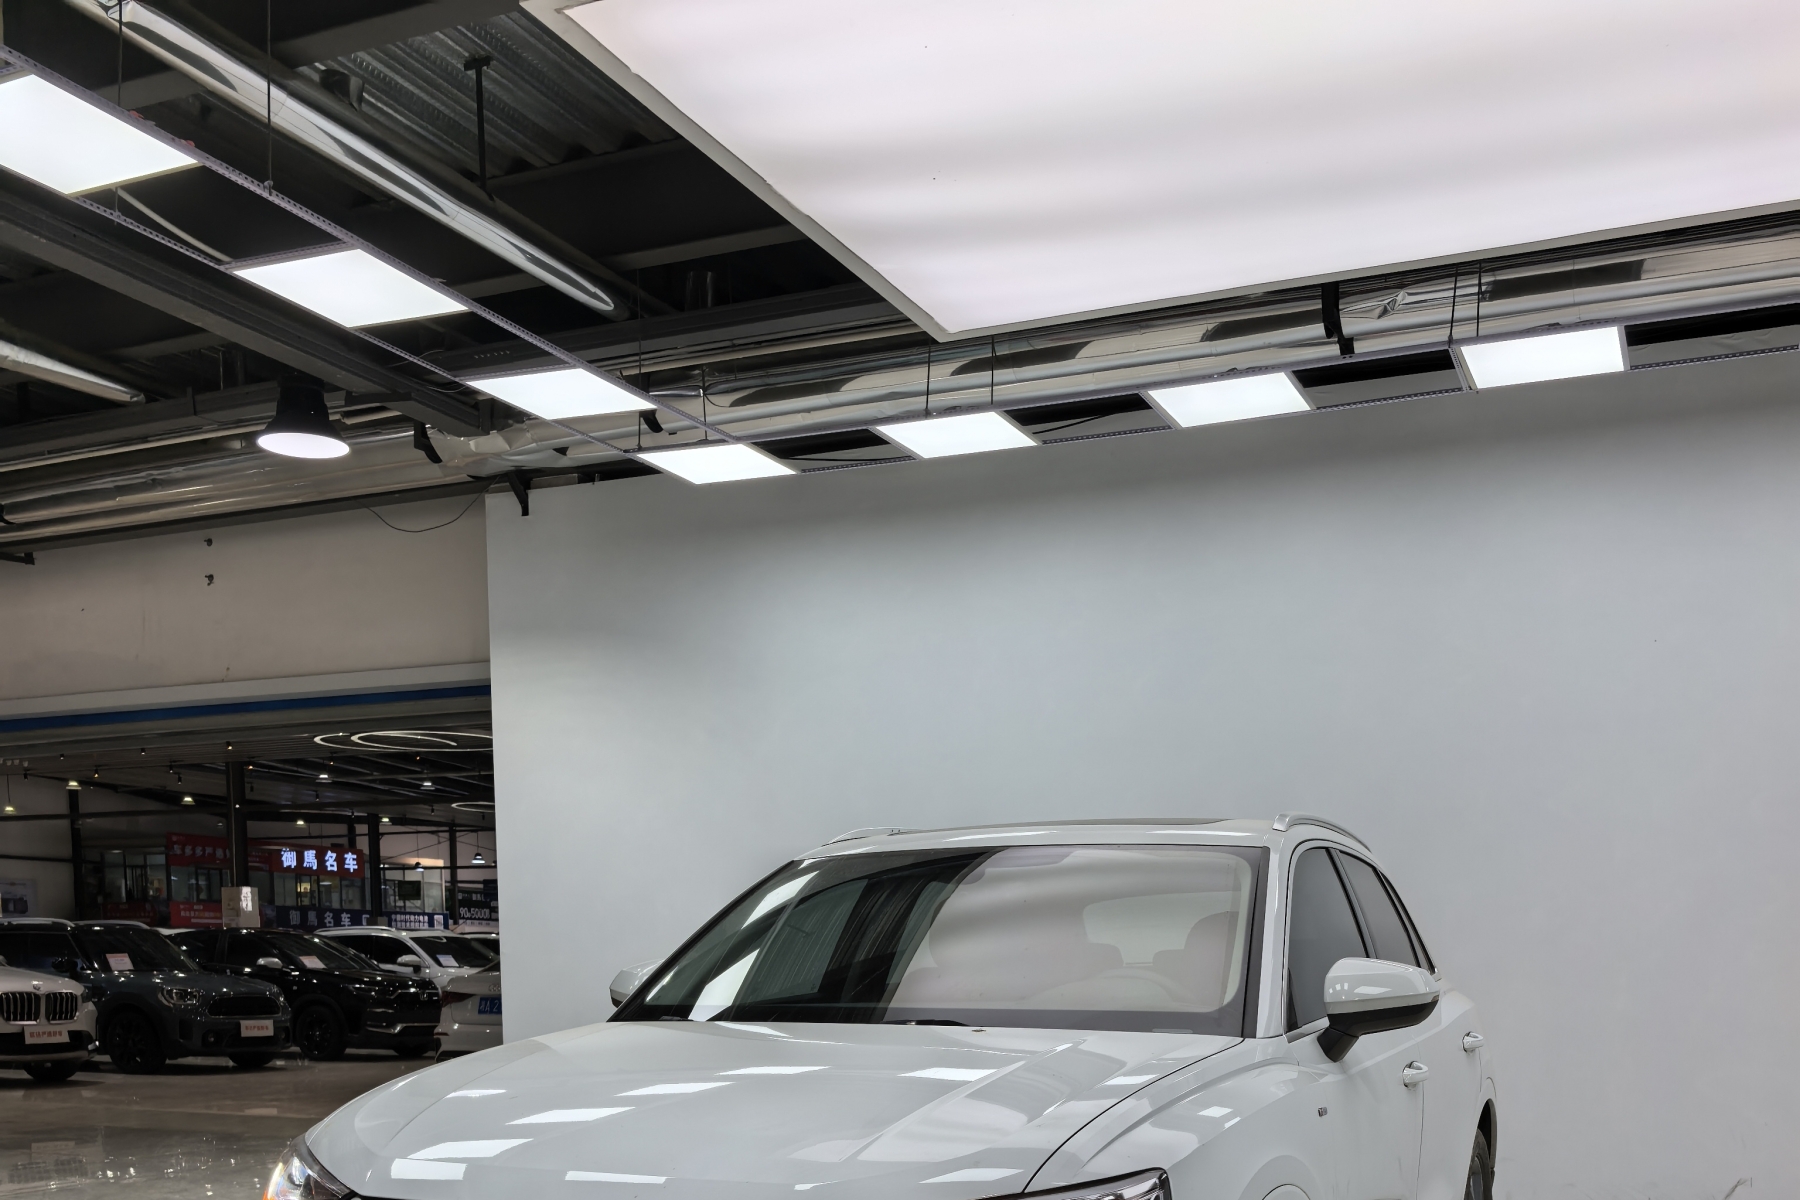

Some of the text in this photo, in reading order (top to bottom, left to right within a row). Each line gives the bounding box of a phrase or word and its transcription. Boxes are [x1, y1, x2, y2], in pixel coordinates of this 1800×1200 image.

[281, 847, 359, 873] 御馬名车
[289, 909, 352, 928] 御馬名车
